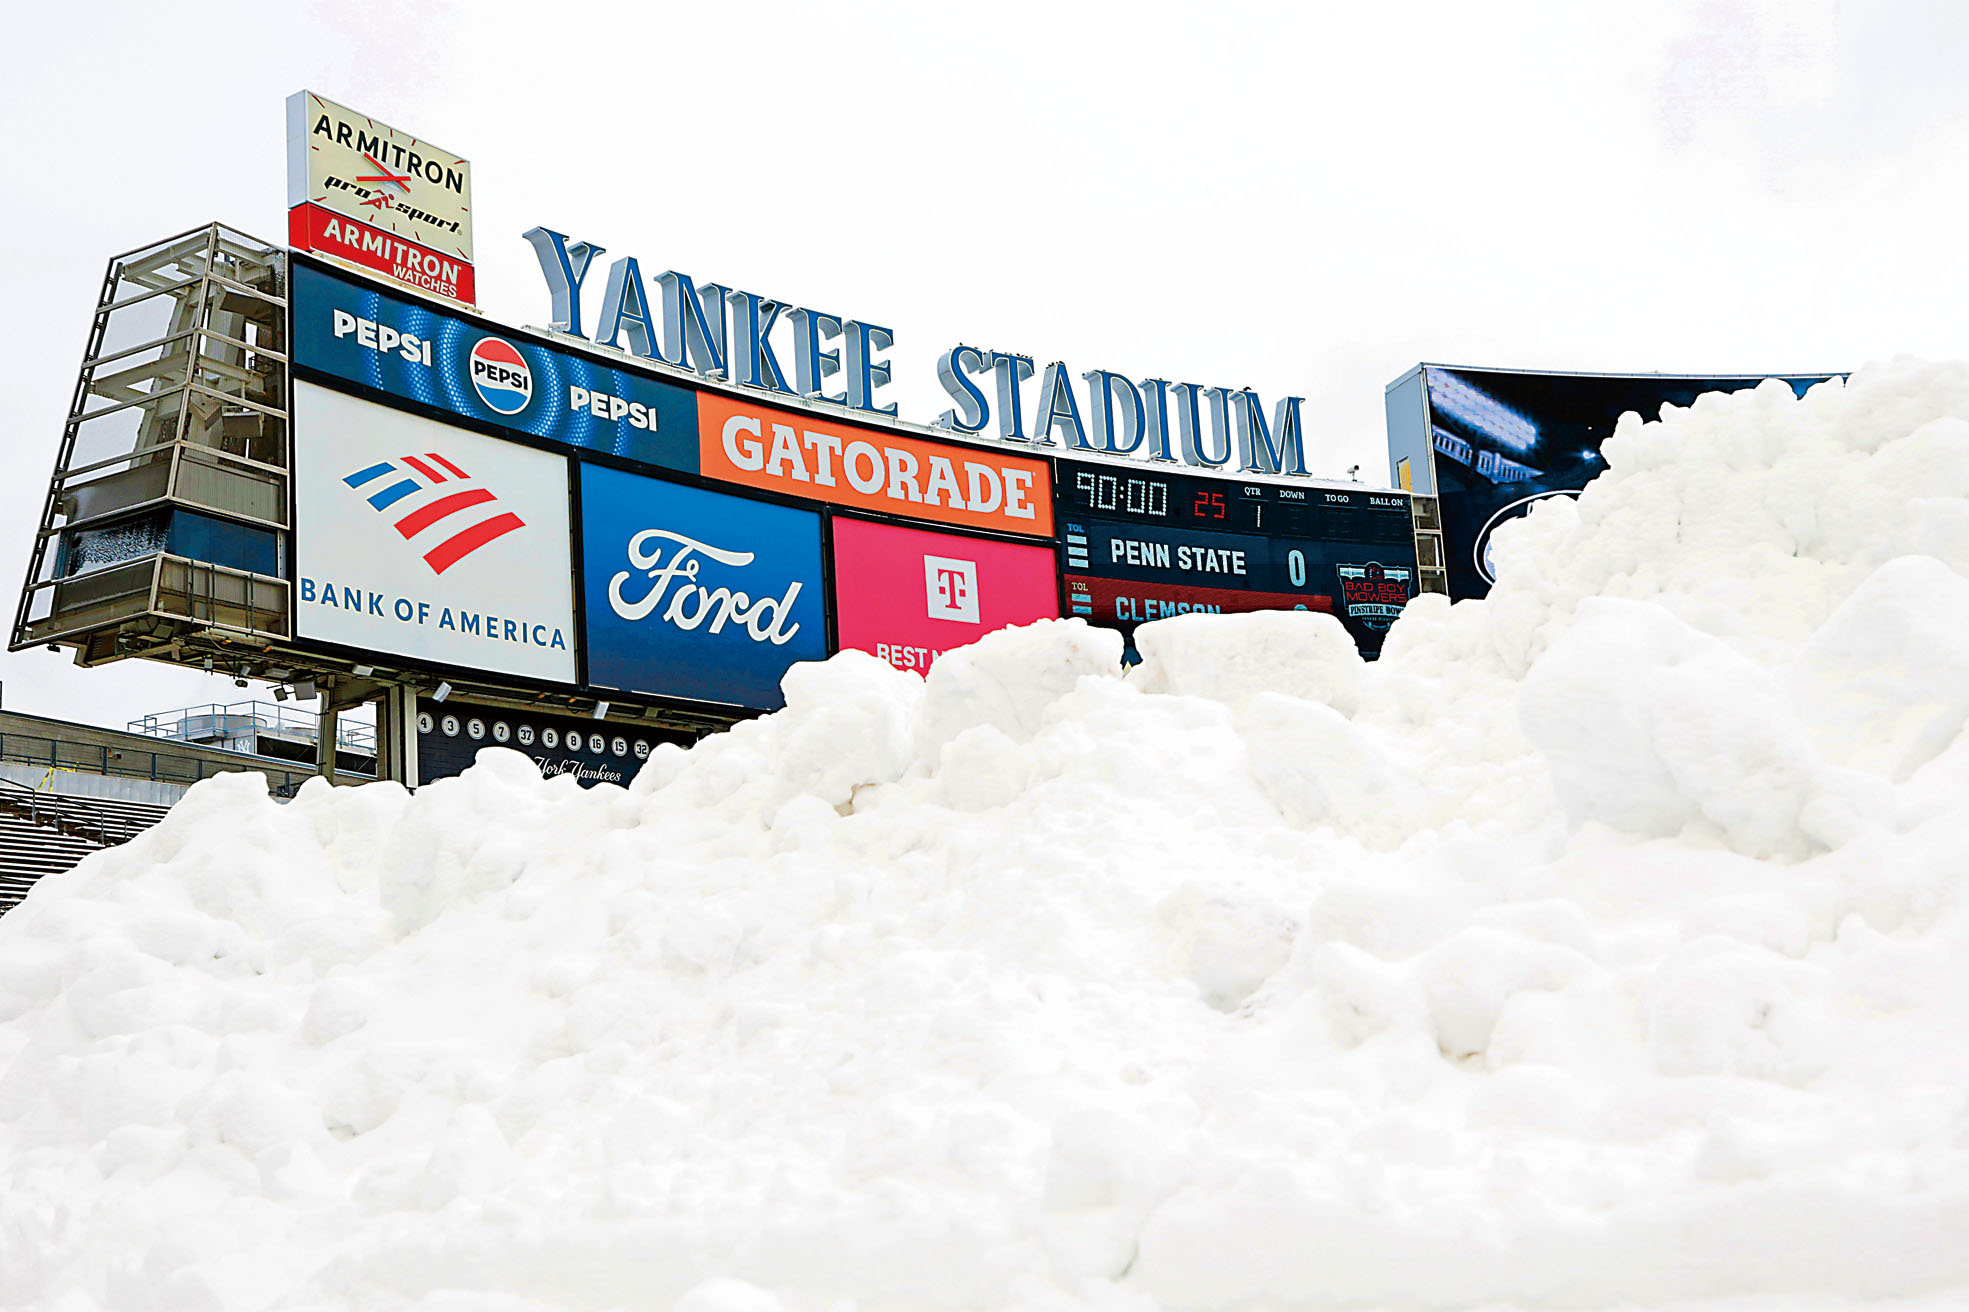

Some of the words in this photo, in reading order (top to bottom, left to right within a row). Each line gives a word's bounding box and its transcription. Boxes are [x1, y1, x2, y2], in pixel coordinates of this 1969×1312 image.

[313, 114, 463, 194] ARMITRON
[324, 176, 371, 199] pro
[324, 218, 458, 284] ARMITRON
[392, 264, 457, 297] WATCHES
[333, 308, 432, 366] PEPSI
[522, 226, 898, 417] YANKEE
[937, 345, 1312, 477] STADIUM
[474, 360, 528, 390] PEPSI
[570, 385, 657, 432] PEPSI
[722, 415, 1035, 520] GATORADE
[1077, 472, 1167, 516] 90:00
[1194, 491, 1225, 518] 25
[1244, 486, 1261, 496] QTR
[1280, 490, 1304, 500] DOWN
[1325, 494, 1336, 502] TO
[1337, 495, 1349, 503] GO
[1370, 497, 1390, 506] BALL
[1067, 523, 1084, 532] TOL
[1111, 538, 1170, 568] PENN
[1177, 546, 1246, 575] STATE
[1288, 550, 1306, 587] 0
[608, 528, 803, 646] Ford
[1072, 582, 1088, 592] TOL
[1346, 582, 1374, 592] BAD
[1378, 583, 1406, 592] BOY
[1346, 592, 1408, 602] MOWERS
[301, 578, 385, 618] BANK
[394, 600, 430, 626] OF
[438, 608, 567, 651] AMERICA
[1350, 605, 1384, 615] PINSTRIPE
[1386, 606, 1404, 616] BOW
[877, 643, 928, 668] BEST
[420, 718, 427, 728] 4
[448, 721, 454, 731] 3
[474, 724, 480, 734] 5
[498, 727, 504, 737] 7
[520, 730, 532, 740] 37
[547, 733, 553, 743] 8
[571, 736, 577, 746] 8
[592, 738, 601, 749] 16
[615, 742, 624, 751] 15
[636, 744, 646, 754] 32
[534, 756, 568, 774] York
[569, 760, 621, 781] Yankees
